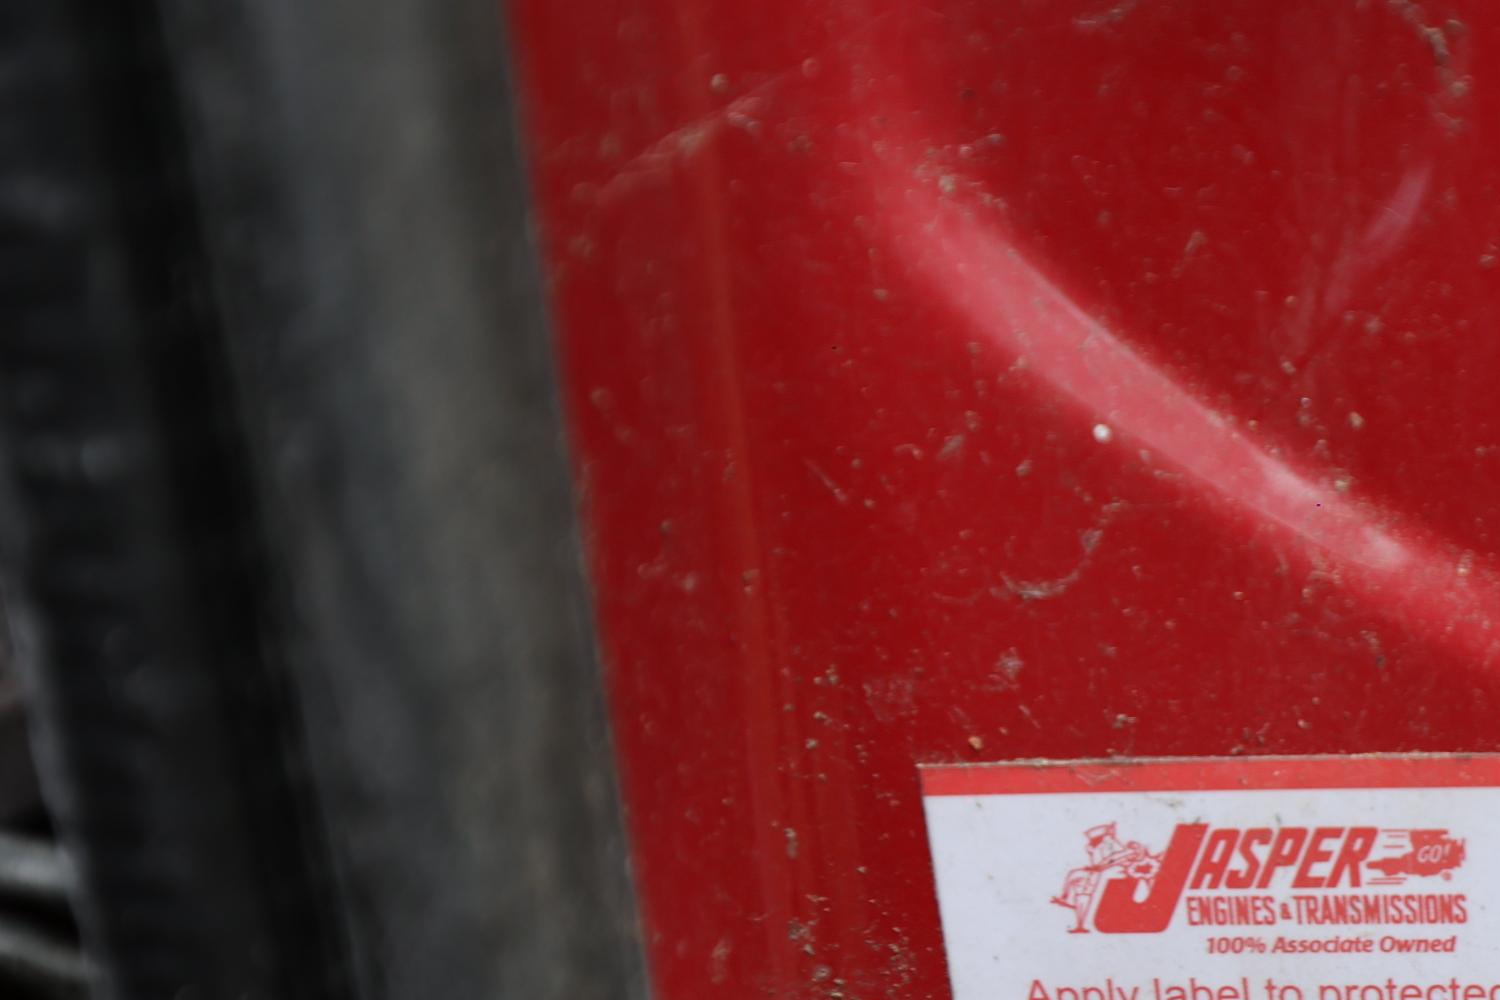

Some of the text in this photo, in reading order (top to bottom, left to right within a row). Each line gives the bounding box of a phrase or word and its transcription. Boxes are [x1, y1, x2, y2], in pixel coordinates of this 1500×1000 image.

[1415, 842, 1452, 866] GO!
[1095, 823, 1378, 933] JASPER
[1186, 895, 1467, 926] ENGINES & TRANSMISSIONS
[1208, 936, 1457, 954] 100% Associate Owned
